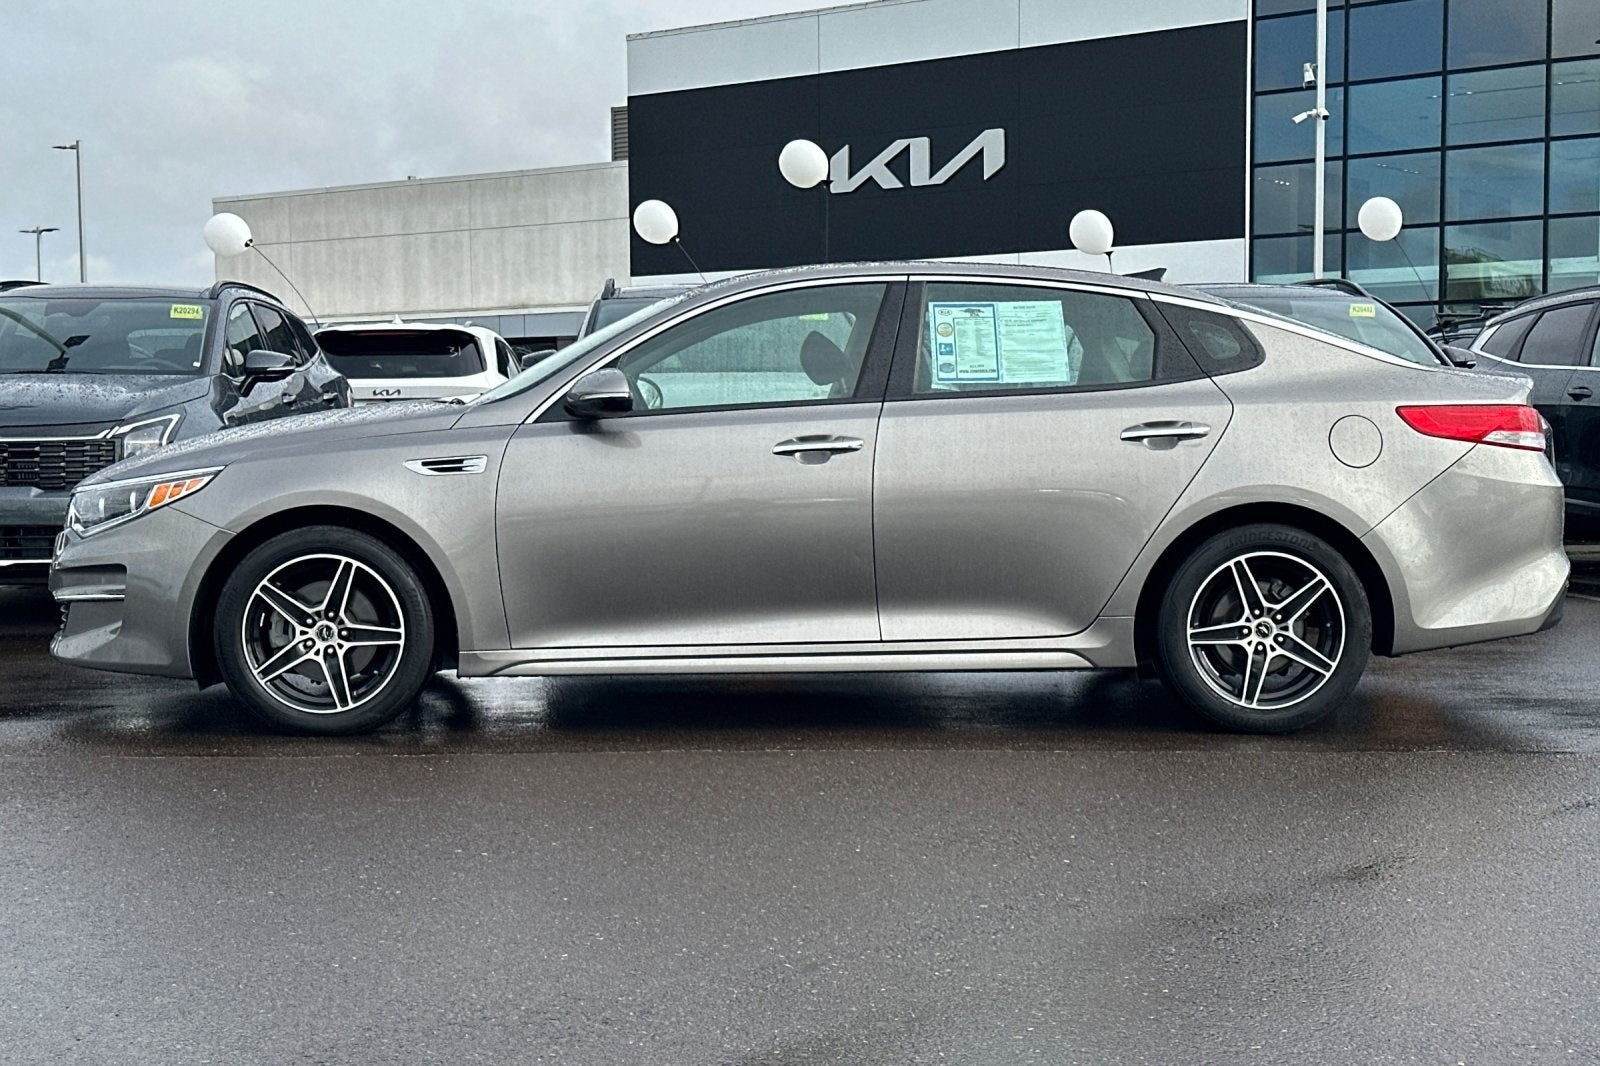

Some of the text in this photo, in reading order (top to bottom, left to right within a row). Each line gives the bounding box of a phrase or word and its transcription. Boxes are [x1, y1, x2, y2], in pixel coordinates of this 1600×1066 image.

[830, 128, 1005, 193] KIA
[173, 306, 200, 315] K20294
[372, 388, 402, 396] KIA
[1225, 532, 1315, 551] BRIDGESTONE
